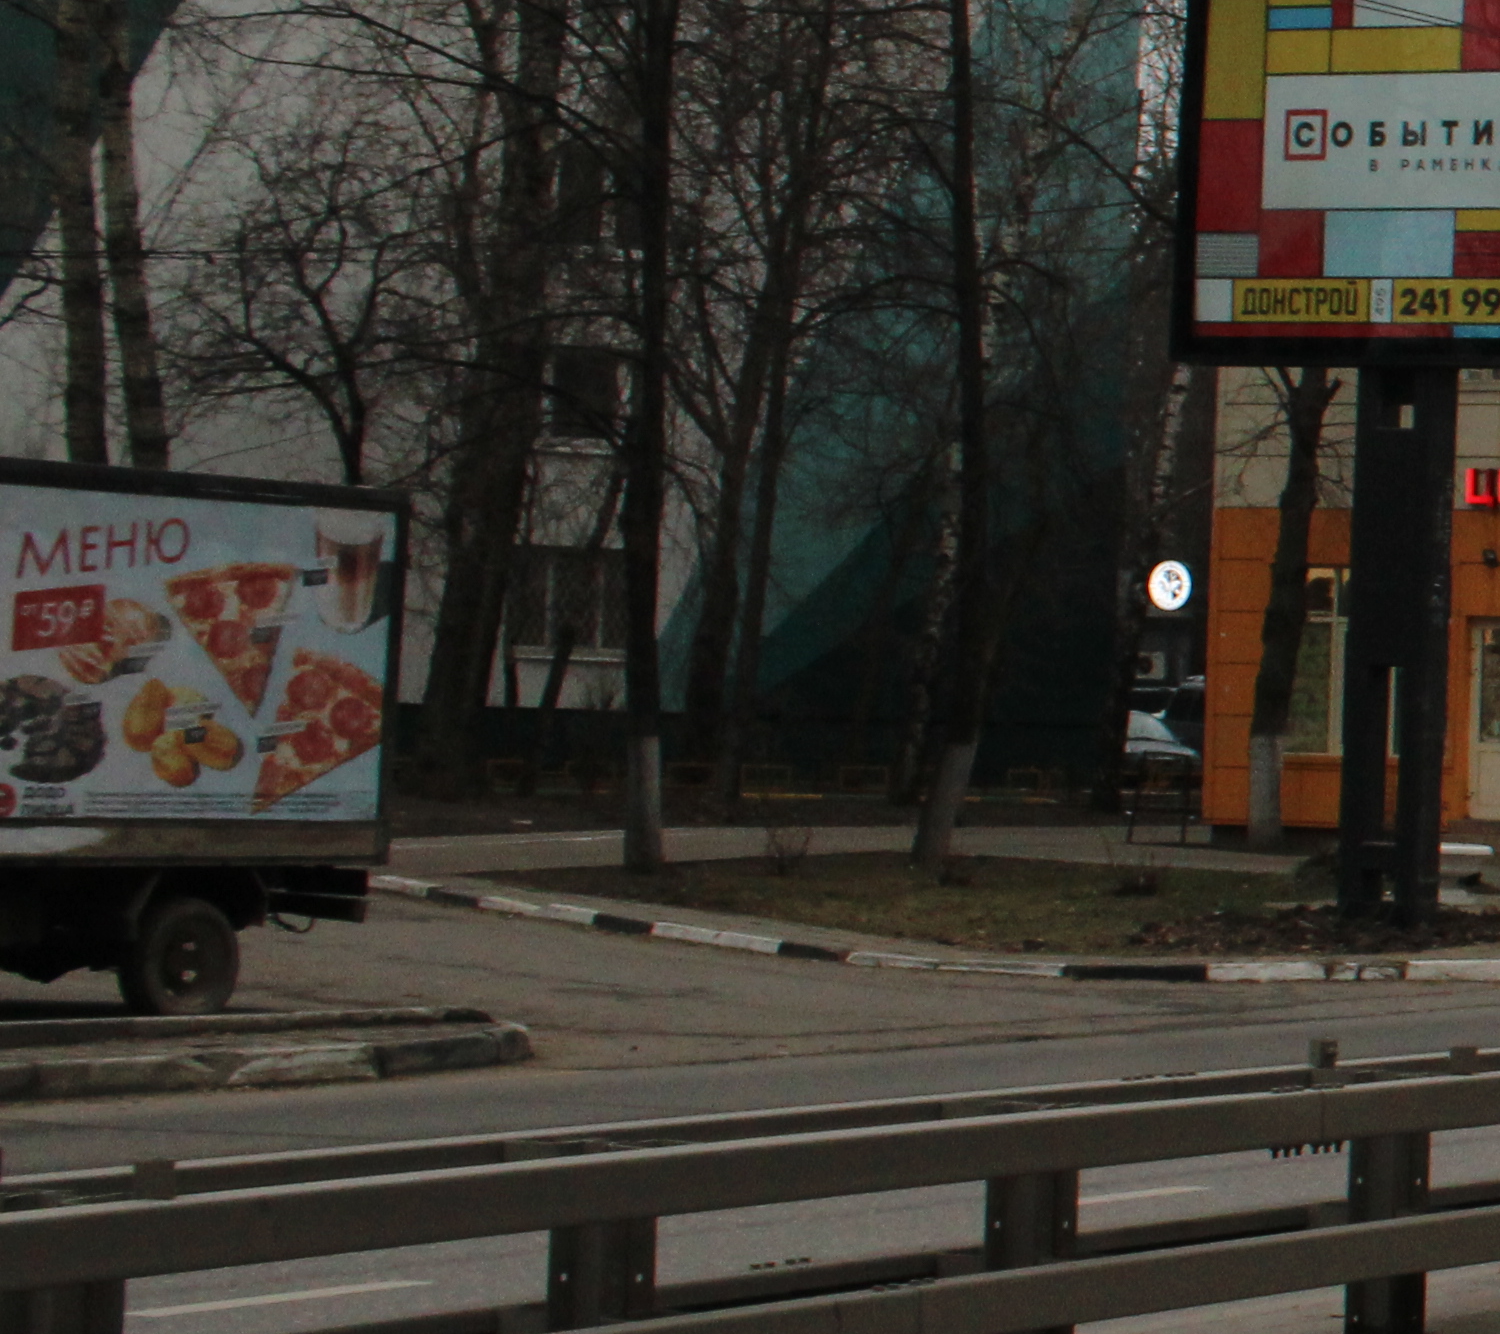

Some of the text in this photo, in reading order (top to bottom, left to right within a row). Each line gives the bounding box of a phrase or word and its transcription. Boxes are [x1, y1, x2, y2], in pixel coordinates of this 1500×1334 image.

[1369, 159, 1380, 172] В
[1240, 280, 1359, 316] ДОНСТРОЙ
[1400, 287, 1451, 316] 241
[15, 517, 192, 579] МЕНЮ
